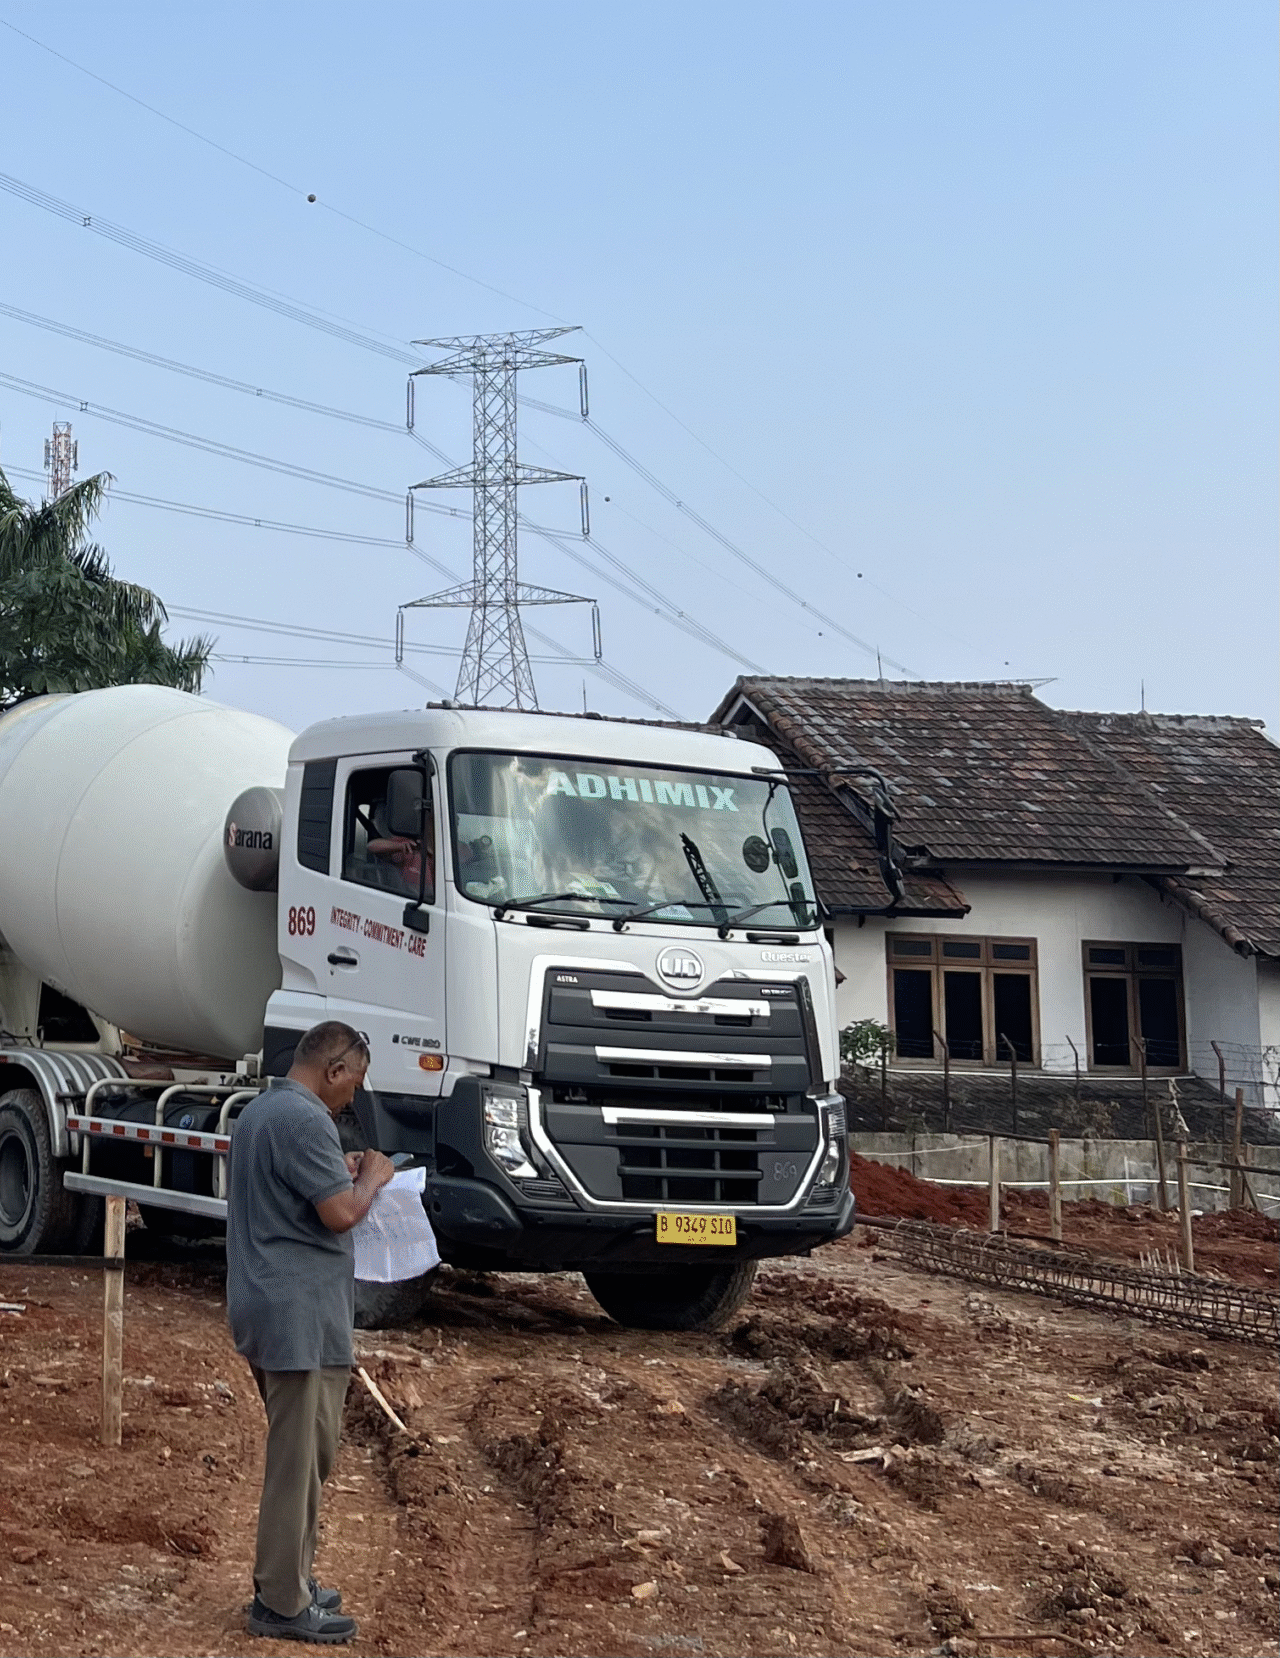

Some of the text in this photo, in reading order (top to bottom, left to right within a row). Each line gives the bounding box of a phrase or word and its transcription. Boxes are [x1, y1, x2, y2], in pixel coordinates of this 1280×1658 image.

[547, 770, 740, 812] ADHIMIX
[287, 905, 316, 936] 869
[330, 905, 427, 958] INTEGRITY COMMITMENT CARE
[761, 949, 812, 964] Quester
[661, 957, 702, 979] UD
[556, 974, 579, 984] ASTRA
[773, 1161, 798, 1182] 869
[660, 1215, 669, 1233] B
[675, 1216, 708, 1235] 9349
